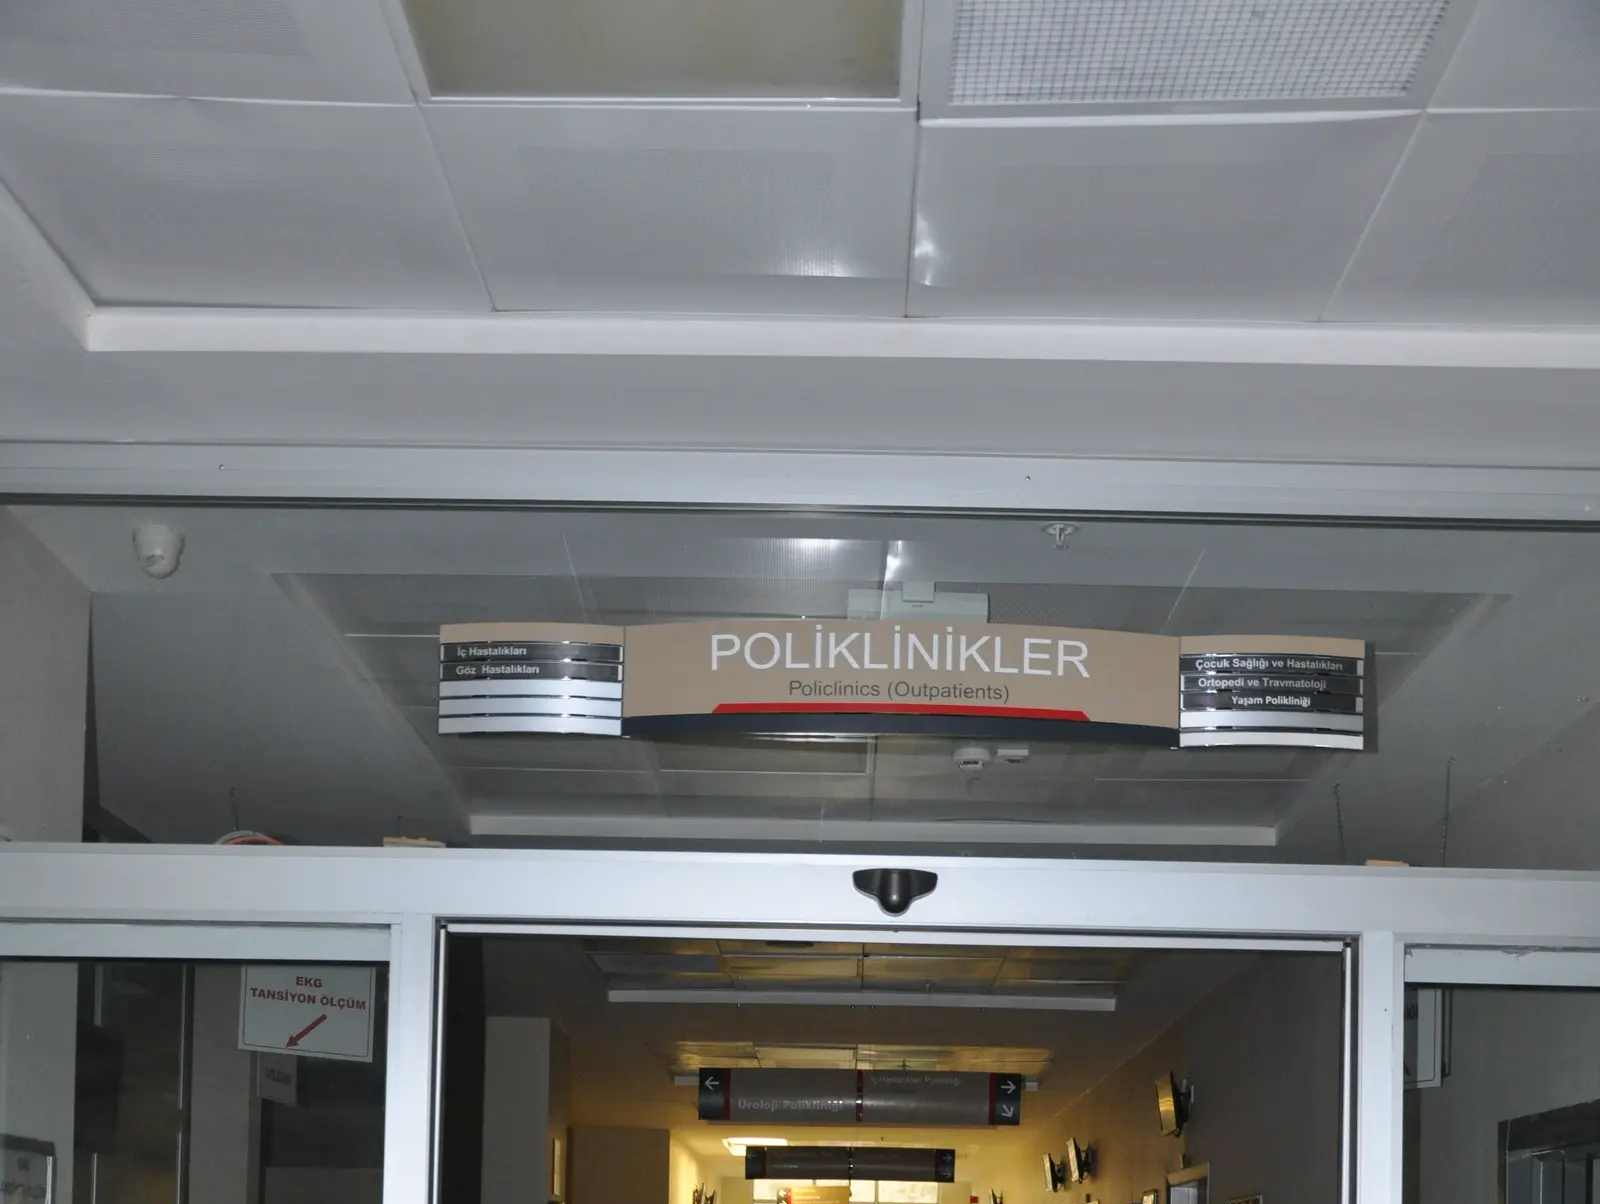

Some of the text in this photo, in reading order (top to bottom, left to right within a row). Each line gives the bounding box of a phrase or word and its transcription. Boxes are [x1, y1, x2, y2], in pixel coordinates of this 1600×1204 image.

[469, 646, 527, 657] Hastalıkları
[709, 623, 1092, 679] POLİKLİNİKLER
[456, 664, 540, 676] Göz Hastalıkları
[1195, 658, 1343, 672] Çocuk Sağlığı ve Hastalıkları
[1198, 677, 1327, 691] Ortopedi ve Travmatoloji
[788, 679, 1010, 705] Policlinics (Outpatients)
[1231, 695, 1311, 708] Yaşam Polikliniği
[295, 976, 322, 988] EKG
[250, 987, 366, 1010] TANSİYON ÖLÇÜM
